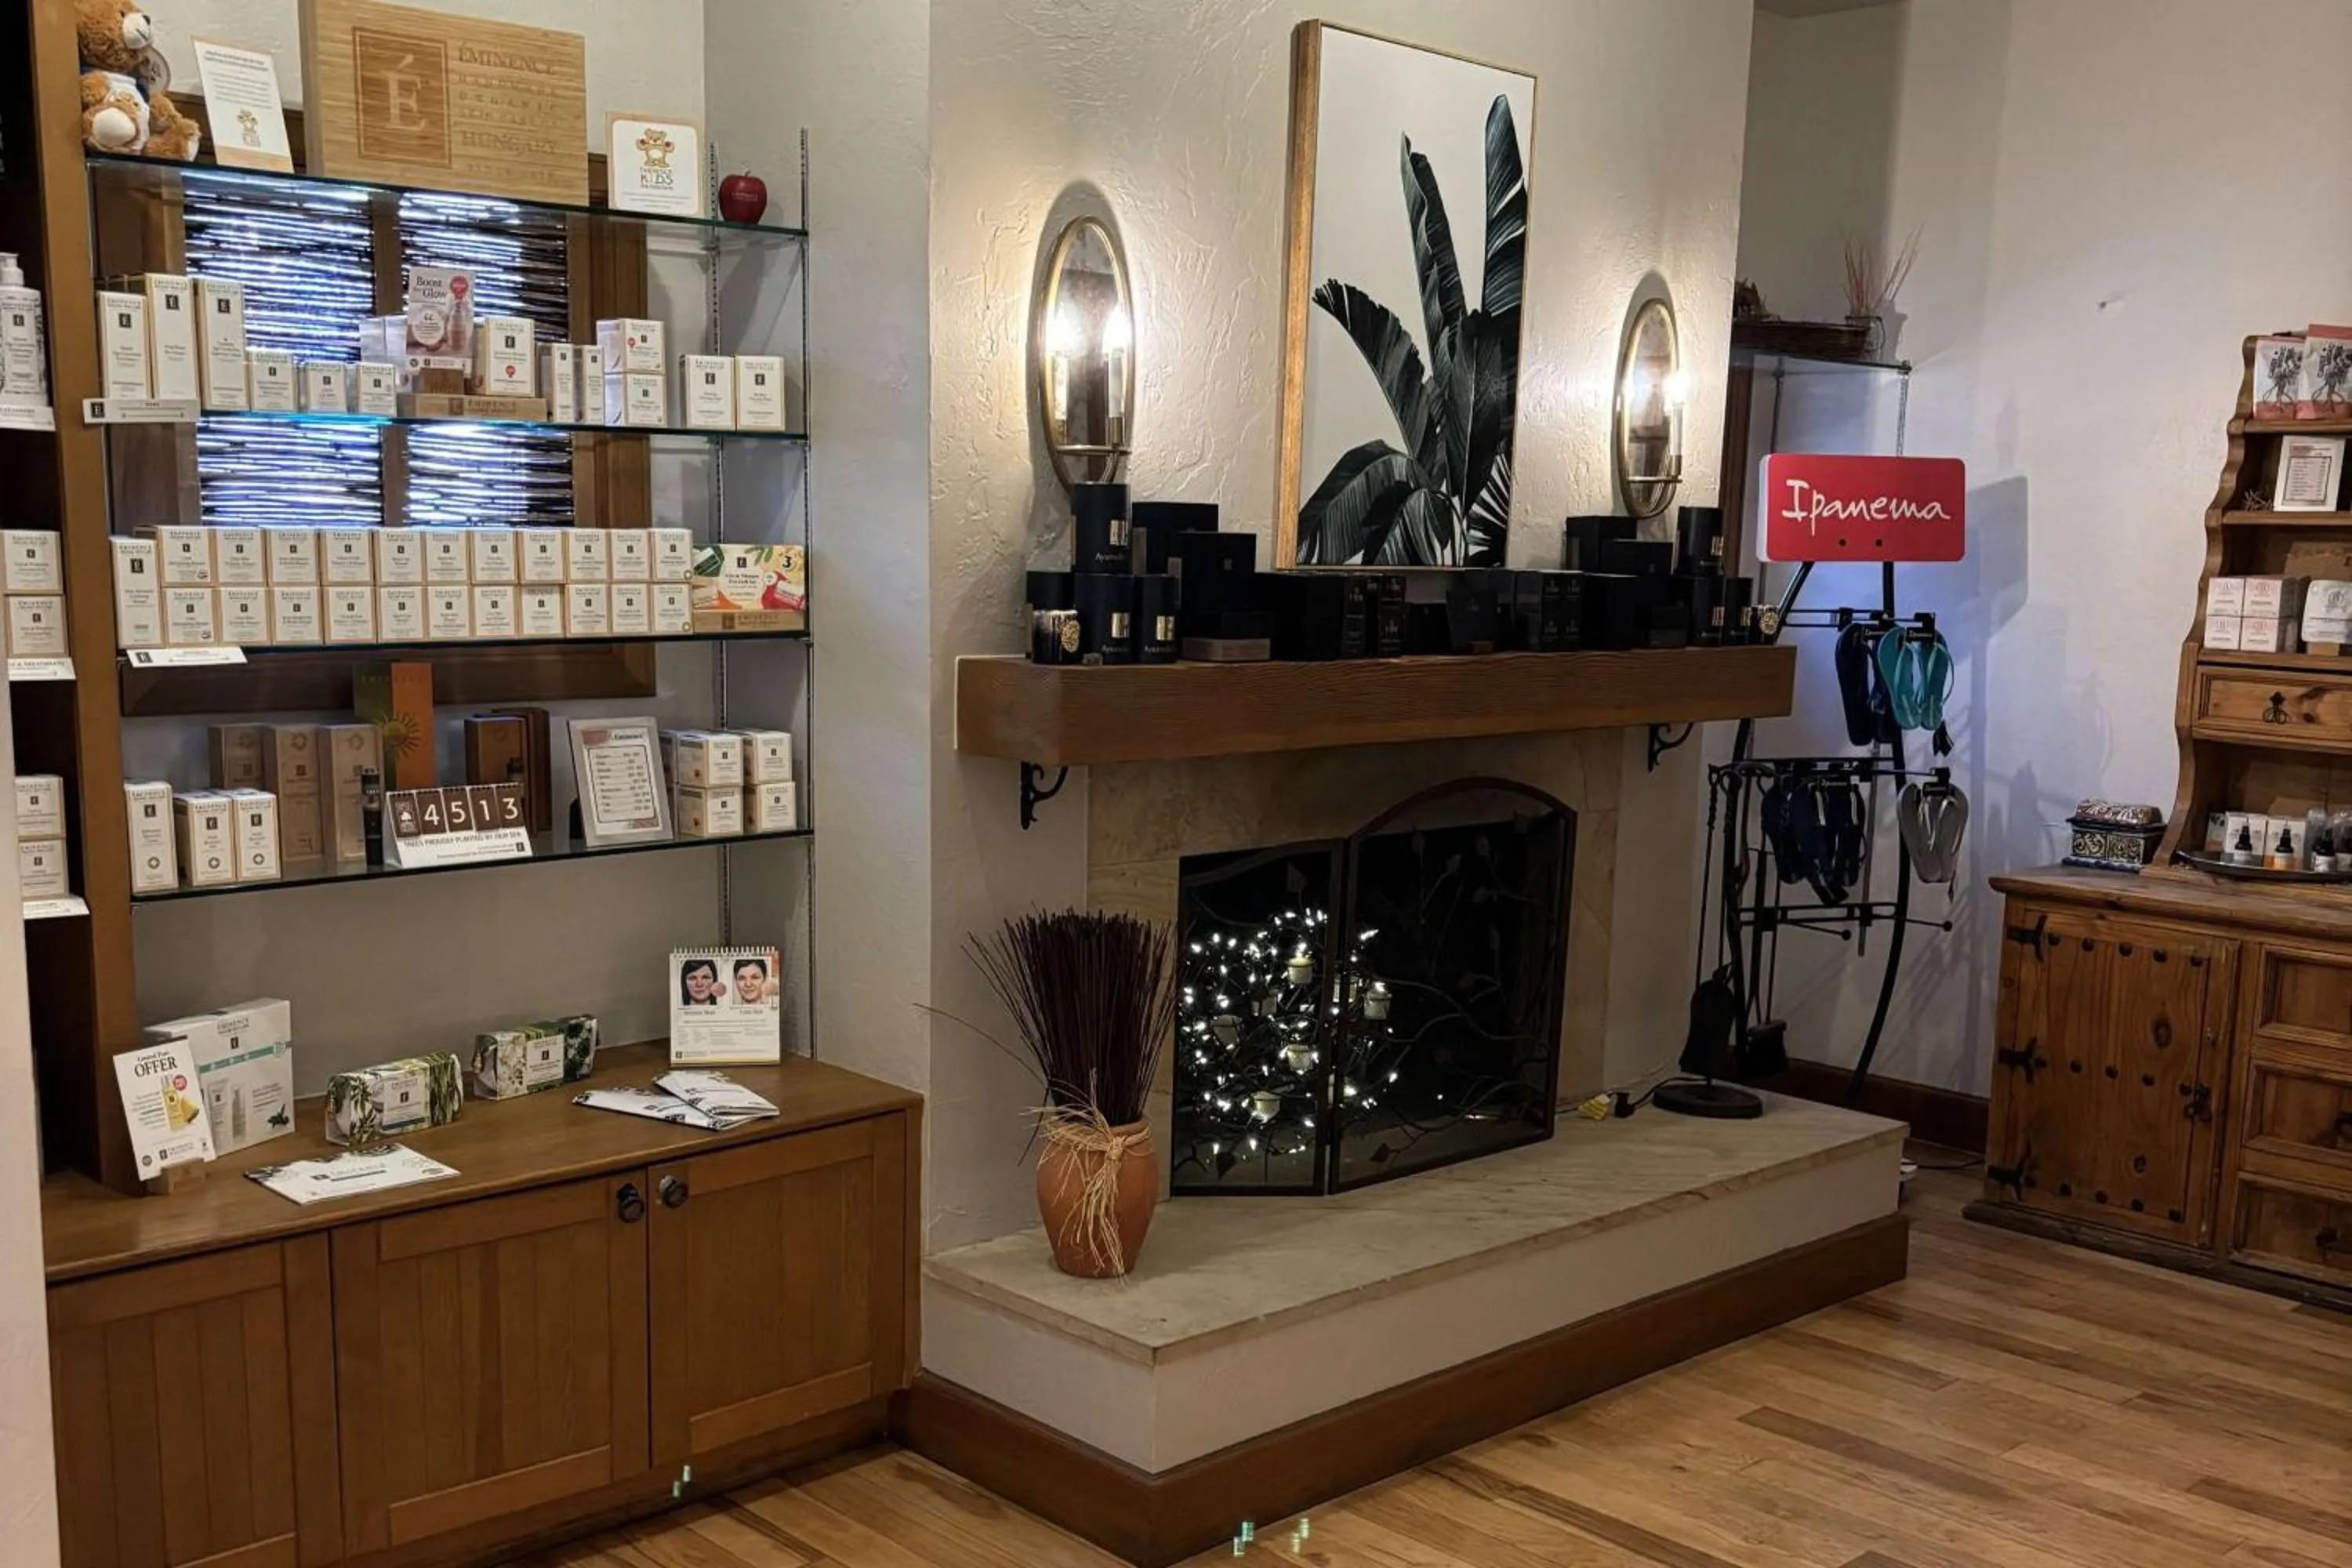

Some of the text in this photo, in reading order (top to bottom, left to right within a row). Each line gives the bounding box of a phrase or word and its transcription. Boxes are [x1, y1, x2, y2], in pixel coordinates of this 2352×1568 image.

[1781, 479, 1951, 536] Ipanema
[782, 555, 792, 568] 3
[134, 1057, 179, 1077] OFFER
